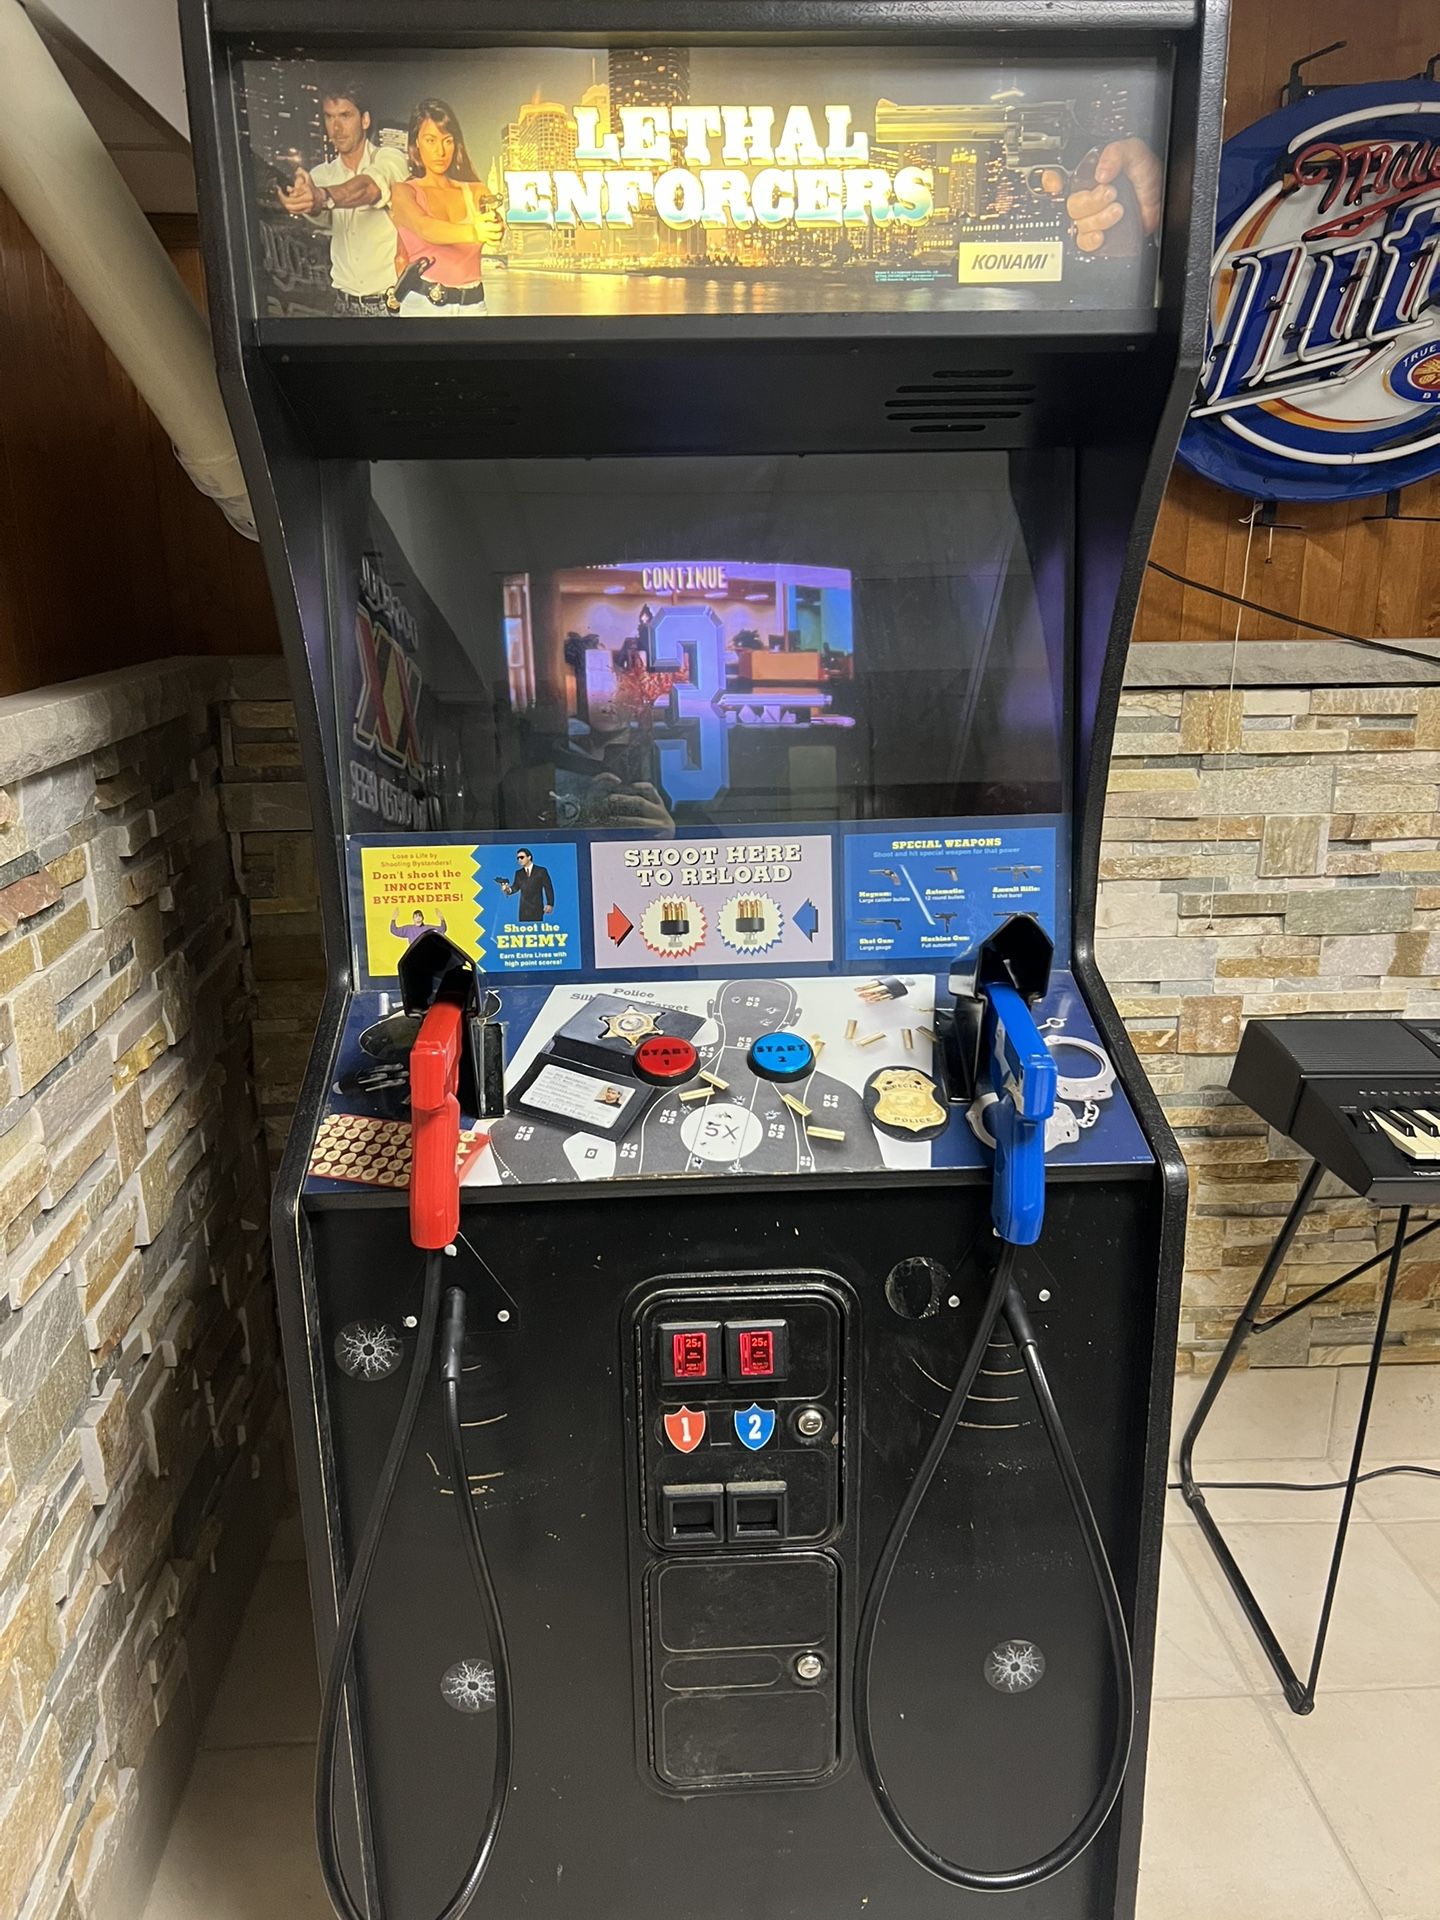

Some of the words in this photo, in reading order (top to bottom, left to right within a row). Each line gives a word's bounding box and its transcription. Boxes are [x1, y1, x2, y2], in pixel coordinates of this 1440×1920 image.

[573, 104, 870, 166] LETHAL
[504, 166, 938, 230] ENFORCERS
[971, 253, 1049, 271] KONAMI
[1402, 344, 1438, 368] TRUE
[642, 566, 728, 590] CONTINUE
[648, 604, 730, 810] 3
[892, 840, 942, 849] SPECIAL
[945, 838, 1002, 847] WEAPONS
[624, 847, 718, 867] SHOOT
[726, 844, 802, 865] HERE
[373, 871, 404, 880] Don't
[407, 870, 439, 879] shoot
[443, 869, 461, 878] the
[637, 868, 673, 887] TO
[681, 865, 792, 886] RELOAD
[384, 882, 451, 892] INNOCENT
[373, 893, 464, 904] BYSTANDERS!
[504, 923, 538, 932] Shoot
[541, 923, 560, 932] the
[497, 933, 568, 949] ENEMY
[613, 988, 655, 998] Police
[645, 1001, 689, 1011] Target
[642, 1047, 690, 1056] START
[757, 1044, 806, 1053] START
[823, 1100, 839, 1109] D4
[661, 1109, 678, 1117] K5
[659, 1116, 676, 1125] D2
[517, 1125, 535, 1133] K3
[769, 1123, 785, 1132] K5
[514, 1132, 532, 1141] D5
[768, 1130, 785, 1139] D2
[622, 1143, 638, 1151] K4
[619, 1150, 637, 1159] D3
[751, 1337, 767, 1347] 25¢
[680, 1417, 692, 1443] 1
[748, 1414, 761, 1440] 2
